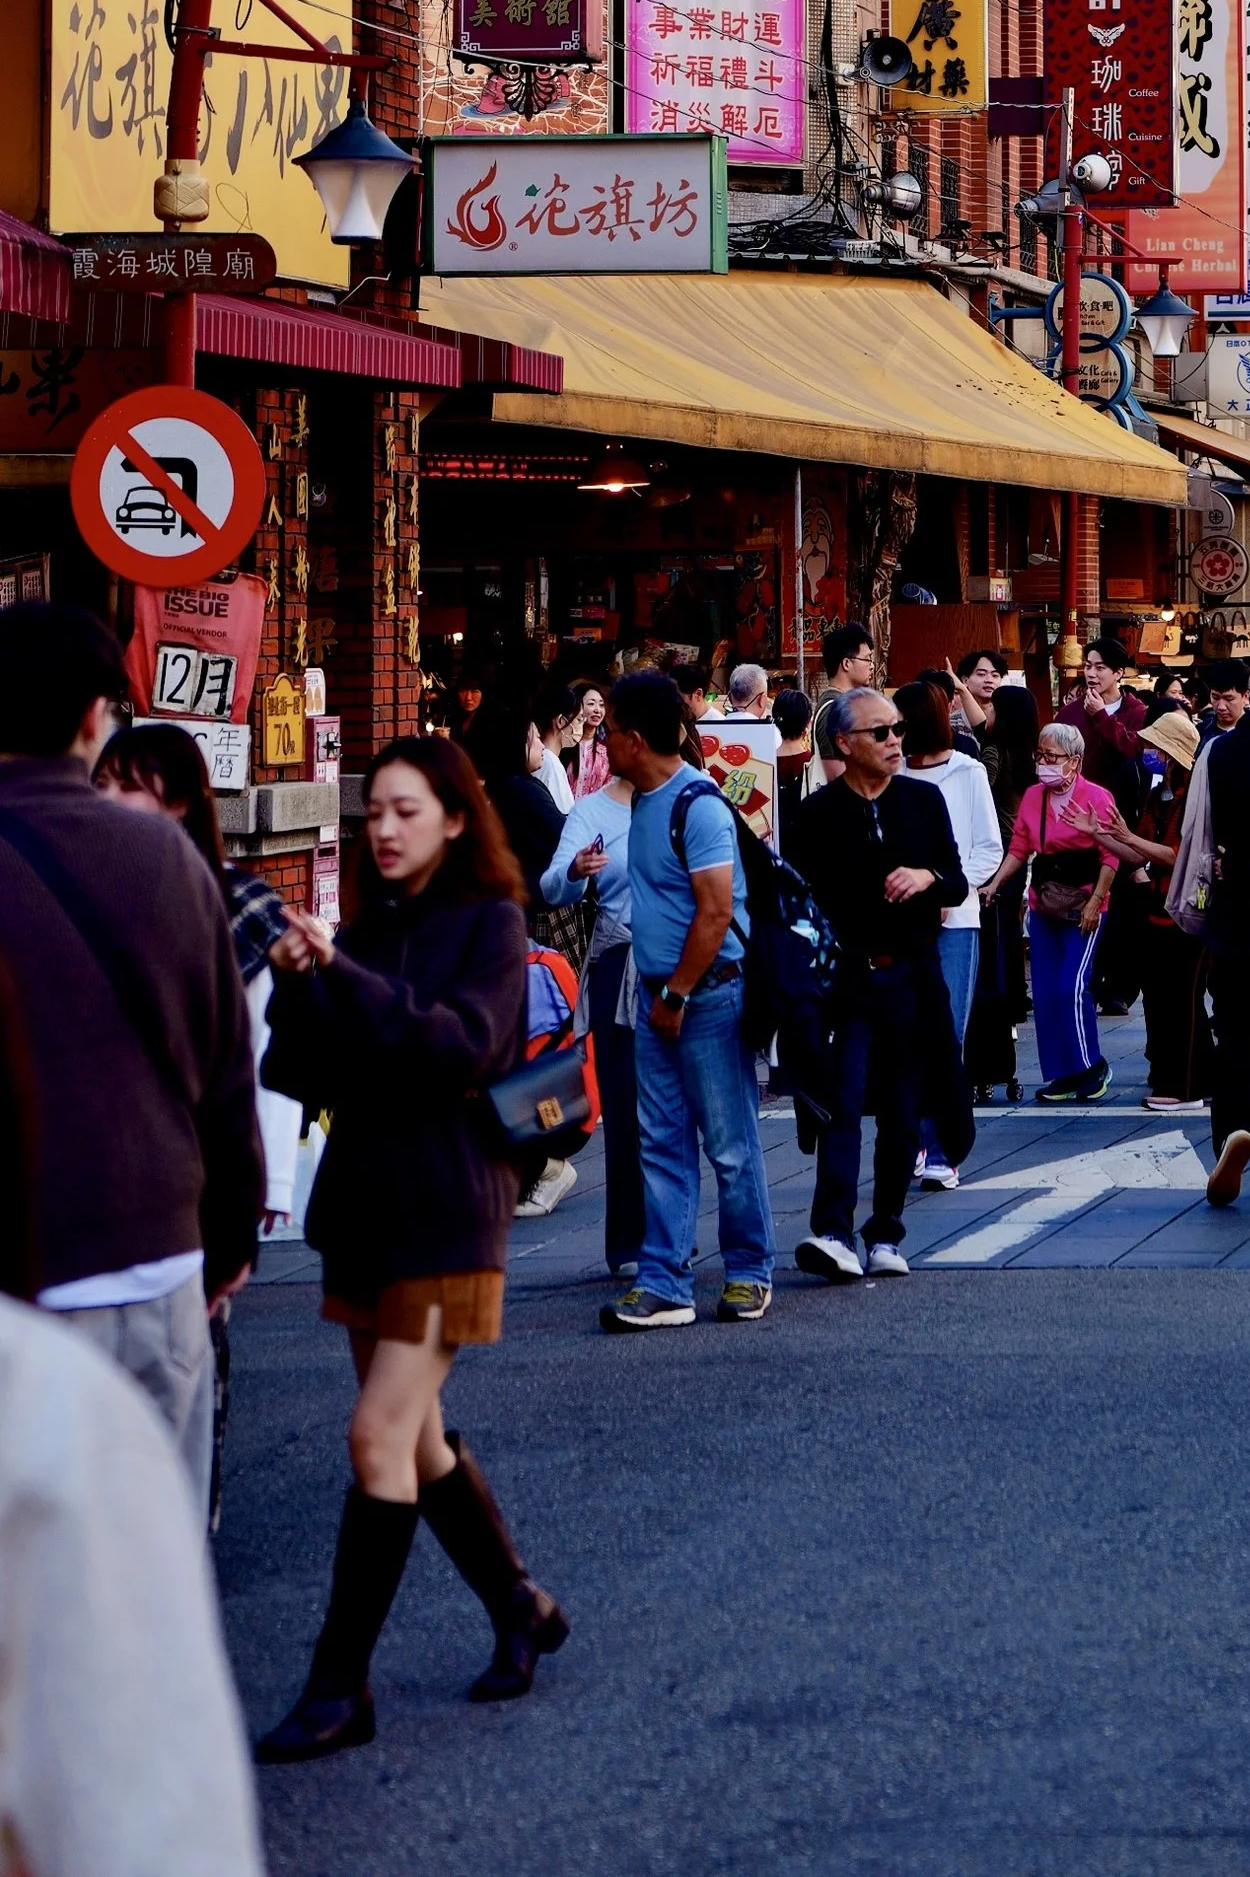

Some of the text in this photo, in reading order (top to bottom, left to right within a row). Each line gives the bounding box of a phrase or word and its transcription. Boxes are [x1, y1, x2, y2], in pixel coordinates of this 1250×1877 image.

[647, 5, 783, 47] 事業財運
[648, 52, 784, 93] 祈福禮斗
[1128, 88, 1159, 97] Coffee
[648, 99, 784, 140] 消災解厄
[1128, 133, 1163, 141] Cuisine
[1128, 176, 1146, 186] Gift
[514, 169, 701, 242] 花旗坊
[1146, 237, 1225, 253] Lian Cheng
[72, 247, 256, 280] 霞海城隍廟
[1134, 259, 1237, 273] Chiese Herbal
[202, 590, 230, 601] BIG
[164, 594, 229, 618] ISSUE
[163, 623, 228, 638] OFFICIAL VENDOR
[158, 653, 233, 715] 12月
